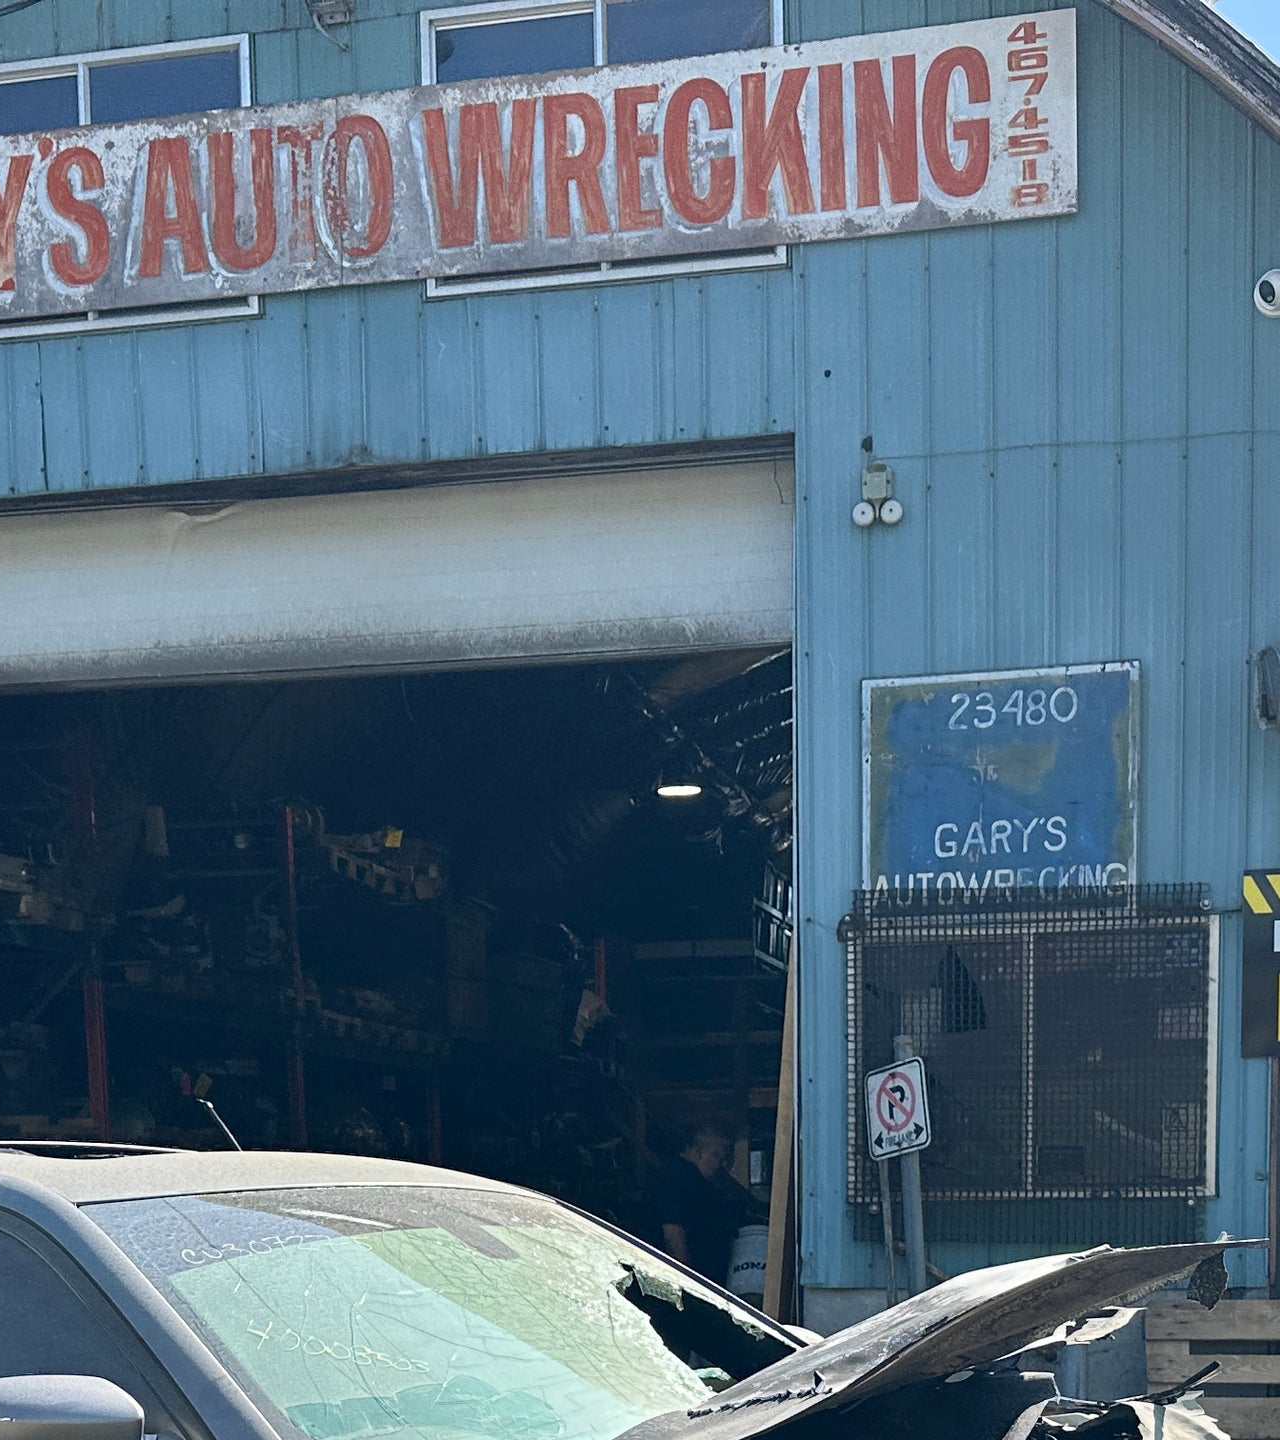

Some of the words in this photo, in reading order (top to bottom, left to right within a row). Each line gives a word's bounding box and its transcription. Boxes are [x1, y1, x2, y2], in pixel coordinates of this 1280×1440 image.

[137, 114, 395, 279] AUTO
[421, 45, 991, 249] WRECKING
[948, 686, 1078, 730] 23480
[934, 816, 1068, 858] GARY'S
